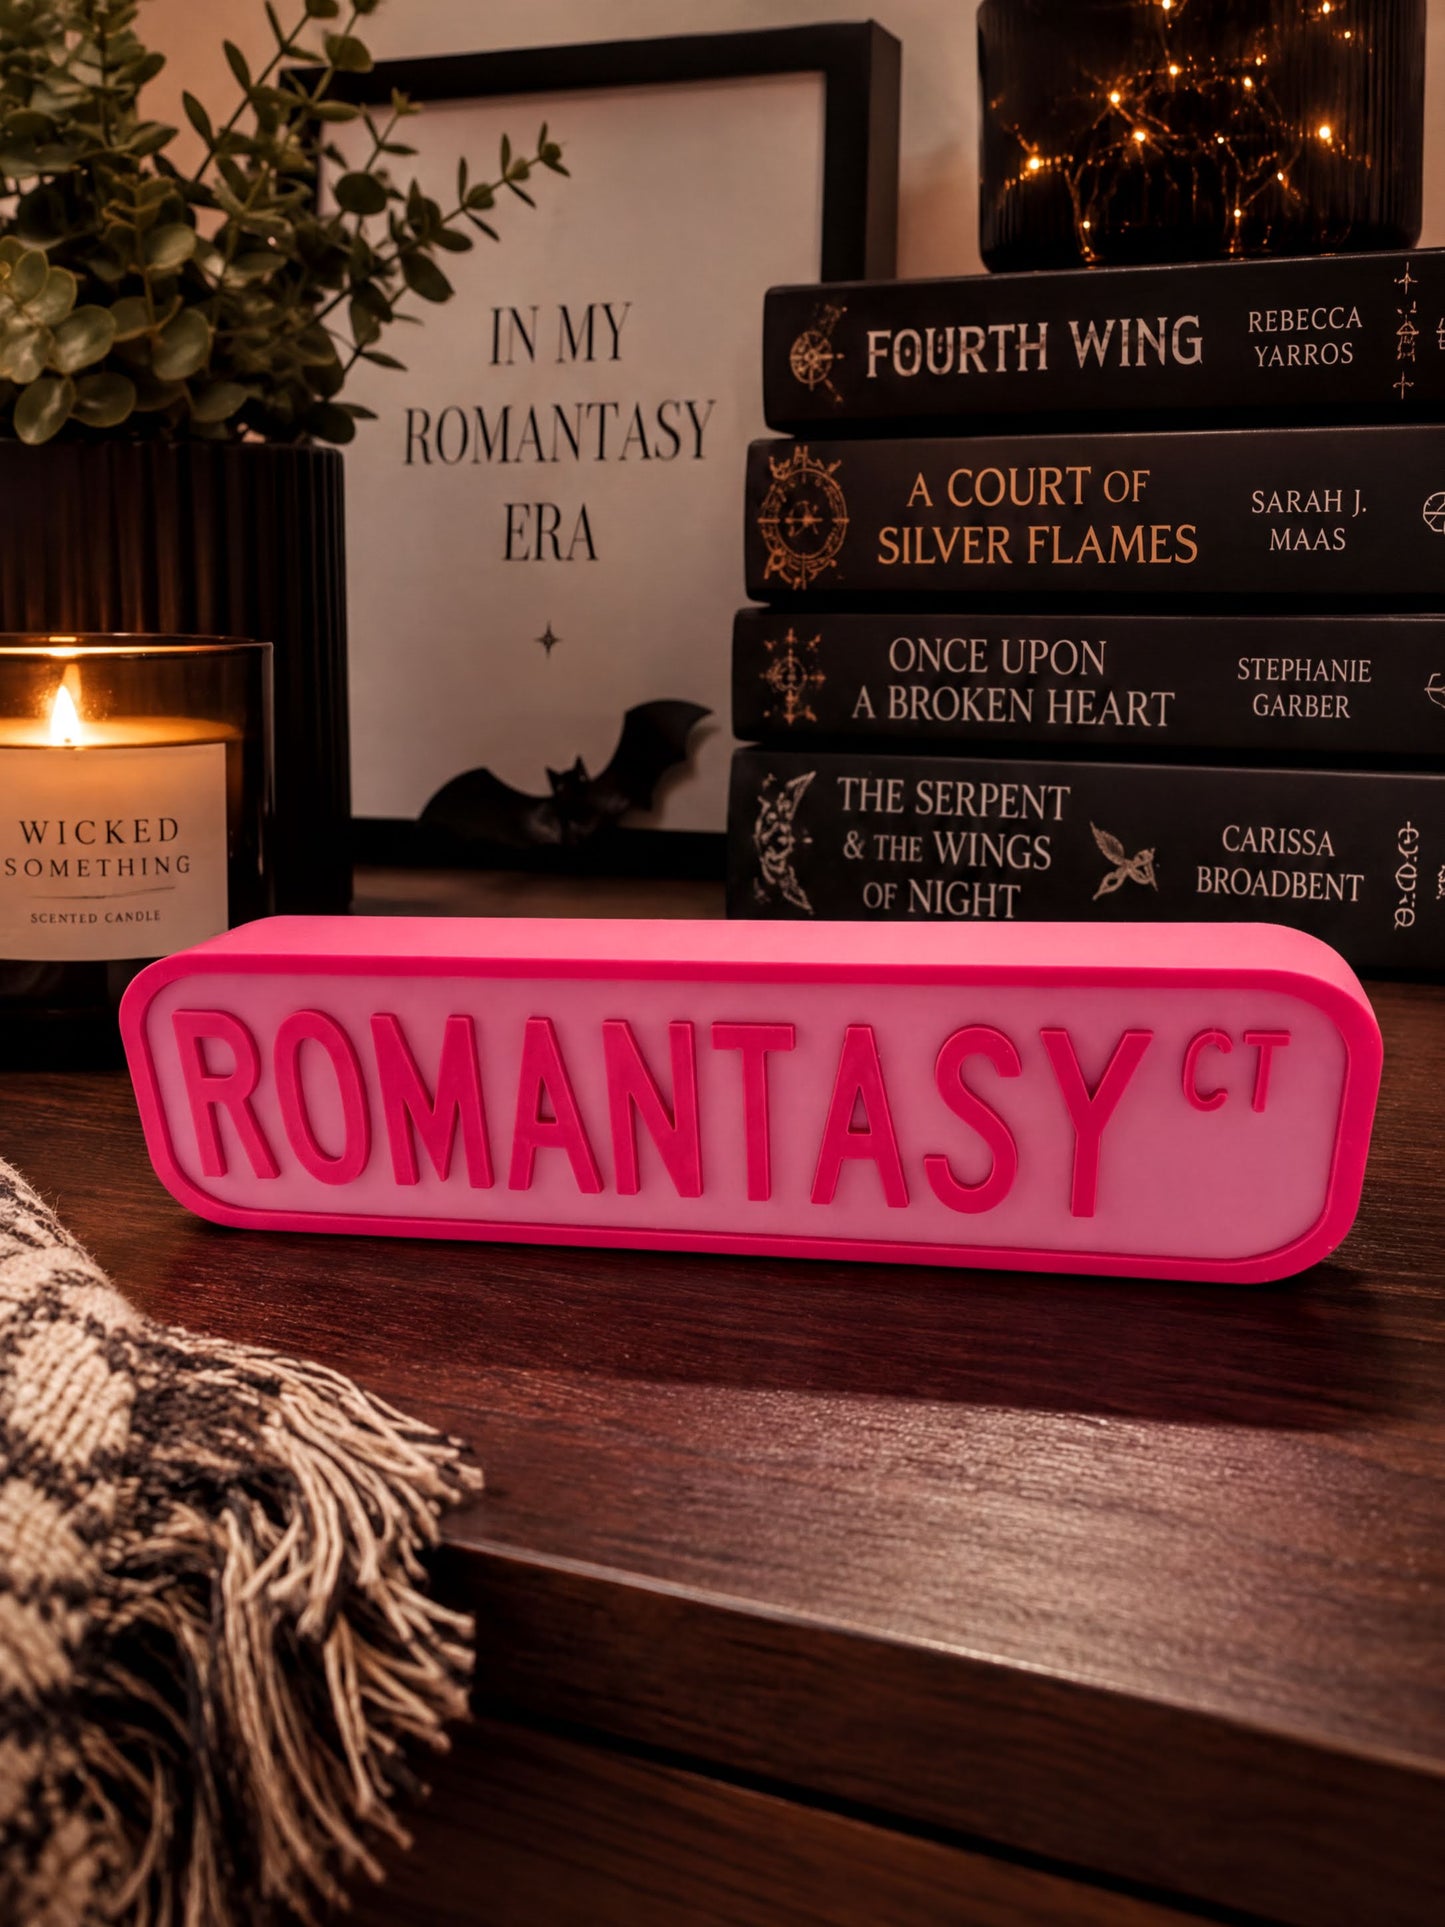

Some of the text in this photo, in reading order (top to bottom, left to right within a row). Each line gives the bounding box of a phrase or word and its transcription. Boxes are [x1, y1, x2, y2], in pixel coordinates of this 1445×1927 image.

[489, 302, 631, 366] IN MY
[1247, 305, 1362, 334] REBECCA
[866, 314, 1203, 379] FOURTH WING
[1253, 342, 1353, 367] YARROS
[403, 399, 716, 465] ROMANTASY
[907, 466, 1150, 506] A COURT OF
[1252, 489, 1367, 517] SARAH J.
[502, 503, 599, 561] ERA
[877, 524, 1198, 565] SILVER FLAMES
[1269, 527, 1346, 551] MAAS
[889, 637, 1107, 676] ONCE UPON
[1237, 658, 1371, 683] STEPHANIE
[851, 686, 1175, 727] A BROKEN HEART
[1252, 694, 1350, 719] GARBER
[837, 776, 1071, 821] THE SERPENT
[19, 818, 179, 844] WICKED
[1222, 825, 1335, 858] CARISSA
[6, 856, 191, 877] SOMETHING
[843, 832, 1052, 871] & THE WINGS
[863, 880, 1020, 919] OF NIGHT
[1197, 866, 1364, 902] BROADBENT
[31, 910, 160, 923] SCENTED CANDLE
[171, 1007, 1292, 1219] ROMANTASY CT
